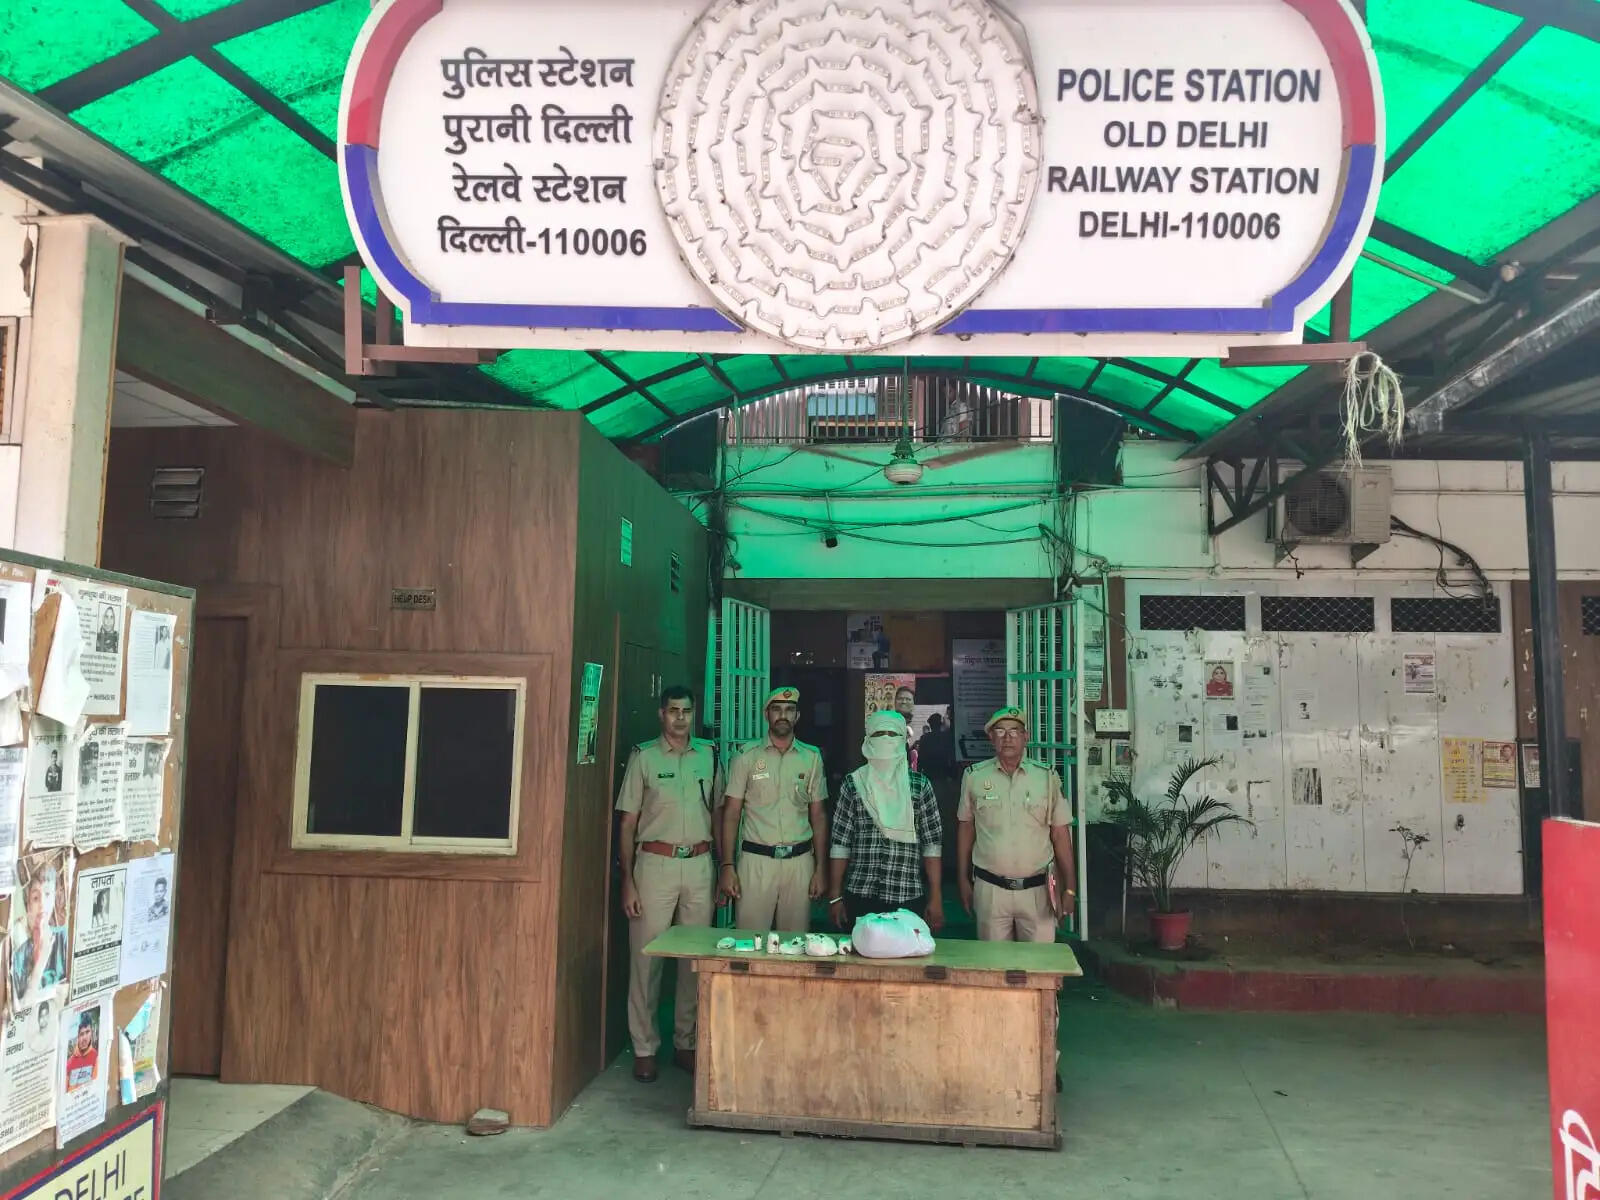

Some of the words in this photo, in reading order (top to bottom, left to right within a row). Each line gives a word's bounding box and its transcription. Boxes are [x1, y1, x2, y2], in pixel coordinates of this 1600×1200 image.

[441, 47, 533, 99] पुलिस
[537, 46, 635, 87] स्टेशन
[1057, 68, 1175, 101] POLICE
[1184, 68, 1321, 102] STATION
[443, 104, 532, 154] पुरानी
[541, 104, 633, 143] दिल्ली
[1103, 121, 1166, 148] OLD
[1176, 121, 1268, 148] DELHI
[452, 163, 522, 202] रेलवे
[532, 163, 627, 202] स्टेशन
[1048, 166, 1181, 193] RAILWAY
[1190, 167, 1319, 194] STATION
[437, 215, 647, 256] दिल्ली-110006
[1078, 211, 1280, 239] DELHI-110006
